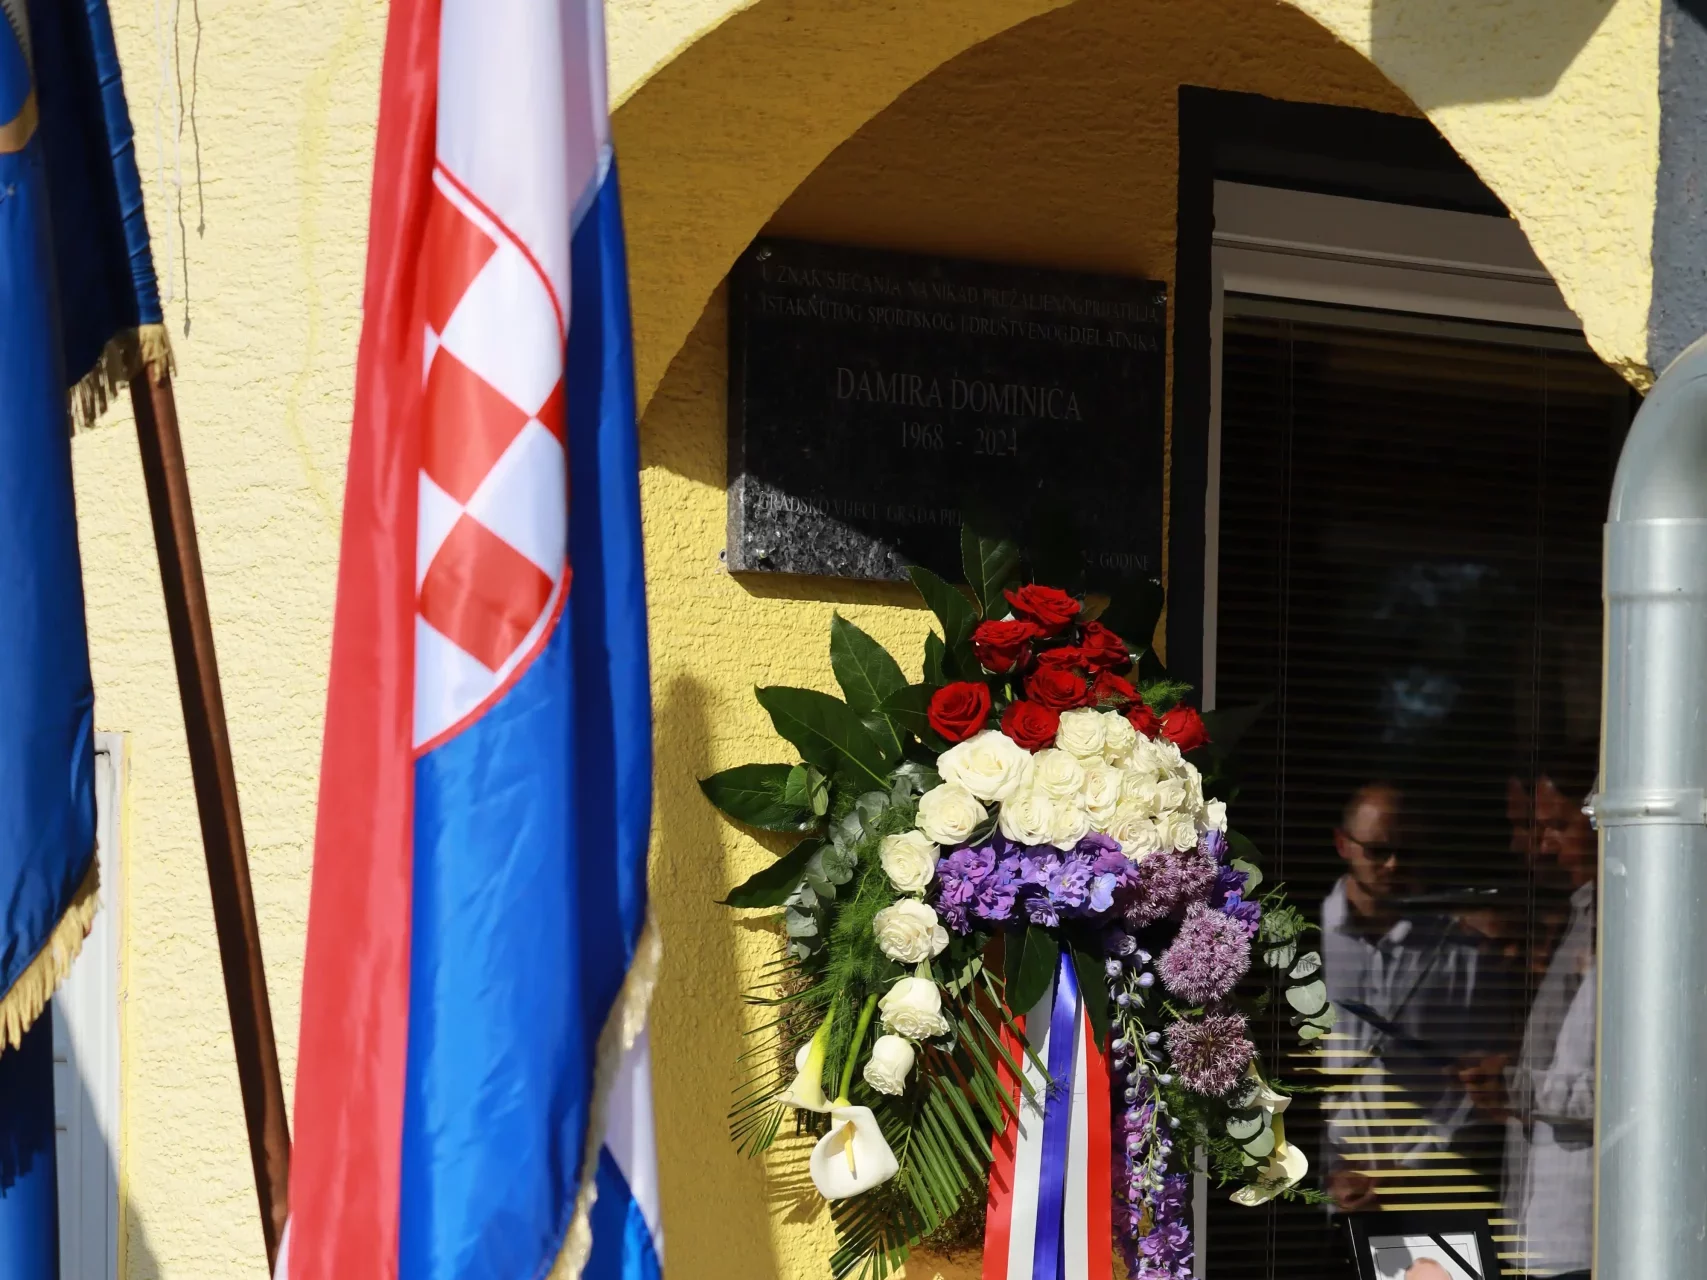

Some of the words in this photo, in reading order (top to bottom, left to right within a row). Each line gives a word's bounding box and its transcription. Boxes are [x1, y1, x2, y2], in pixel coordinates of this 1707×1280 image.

[776, 265, 823, 287] ZNAK
[932, 284, 978, 305] NIKAD
[761, 294, 862, 322] ISTAKNUTOG
[867, 305, 954, 331] SPORTSKOG
[969, 316, 1067, 341] DRUŠTVENOG
[1070, 326, 1157, 353] DJELATNIKA
[836, 366, 943, 408] DAMIRA
[900, 420, 944, 450] 1968
[973, 426, 1018, 456] 2024
[758, 491, 830, 516] GRADSKO
[886, 505, 937, 526] GRADA
[1098, 551, 1150, 571] GODINE
